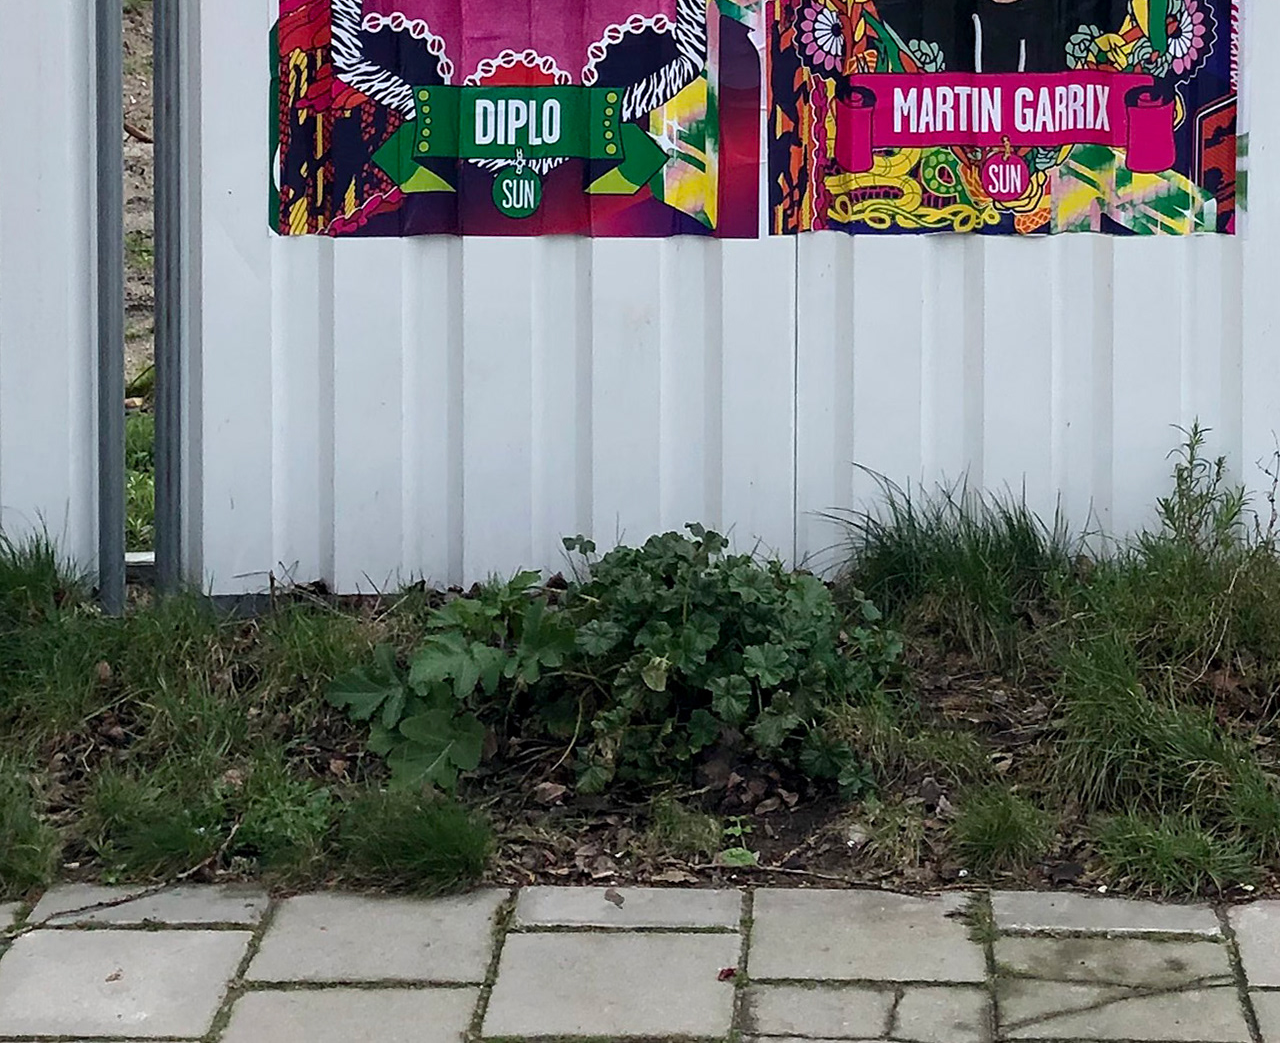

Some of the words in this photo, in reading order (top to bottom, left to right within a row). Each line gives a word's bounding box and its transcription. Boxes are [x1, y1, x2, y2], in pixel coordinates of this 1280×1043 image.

[474, 98, 561, 146] DIPLO
[893, 85, 1002, 133] MARTIN
[1014, 84, 1111, 133] GARRIX
[502, 178, 535, 209] SUN
[988, 164, 1021, 194] SUN
